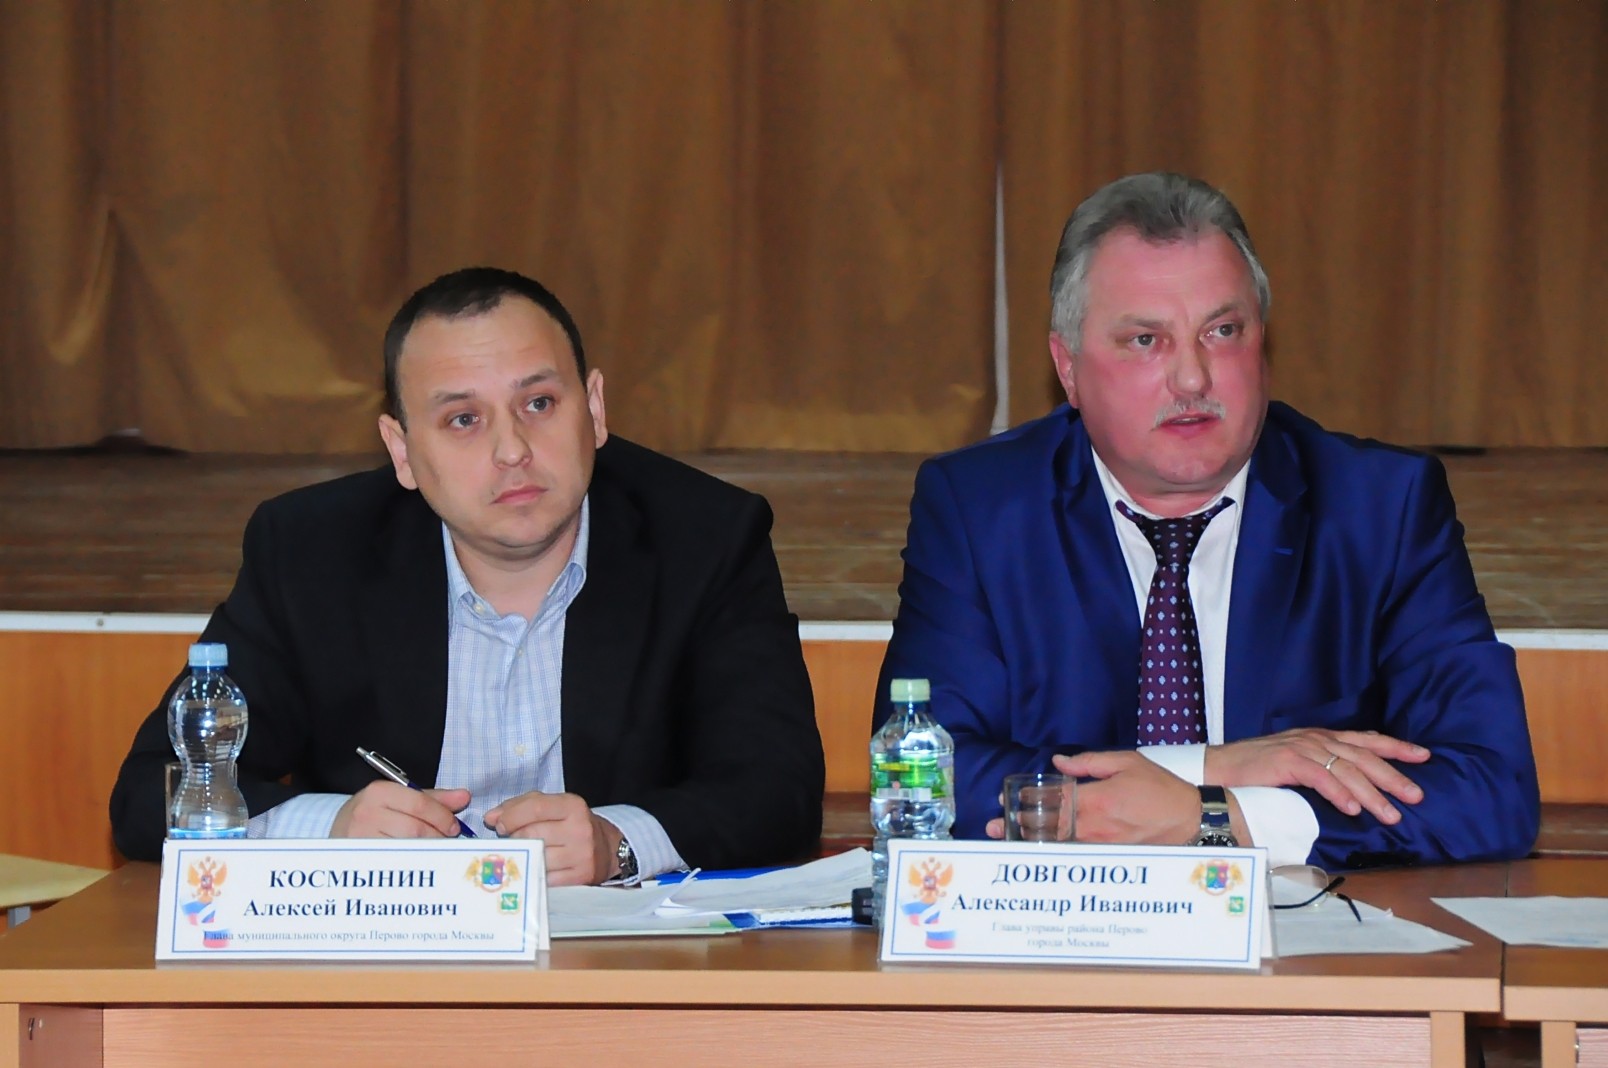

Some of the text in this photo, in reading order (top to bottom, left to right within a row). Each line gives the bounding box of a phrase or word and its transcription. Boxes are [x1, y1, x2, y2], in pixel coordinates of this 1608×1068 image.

[269, 869, 436, 889] КОСМЫНИН
[992, 863, 1148, 885] ДОВГОПОЛ
[243, 897, 458, 917] Алексей Иванович
[951, 893, 1194, 916] Александр Иванович
[237, 931, 328, 943] муниципального
[331, 931, 367, 943] округа
[370, 930, 409, 943] Перово
[411, 931, 448, 943] города
[451, 931, 495, 942] Москвы
[1025, 924, 1065, 937] управы
[1067, 922, 1105, 937] района
[1107, 923, 1148, 937] Перово
[1027, 938, 1110, 951] города Москвы
